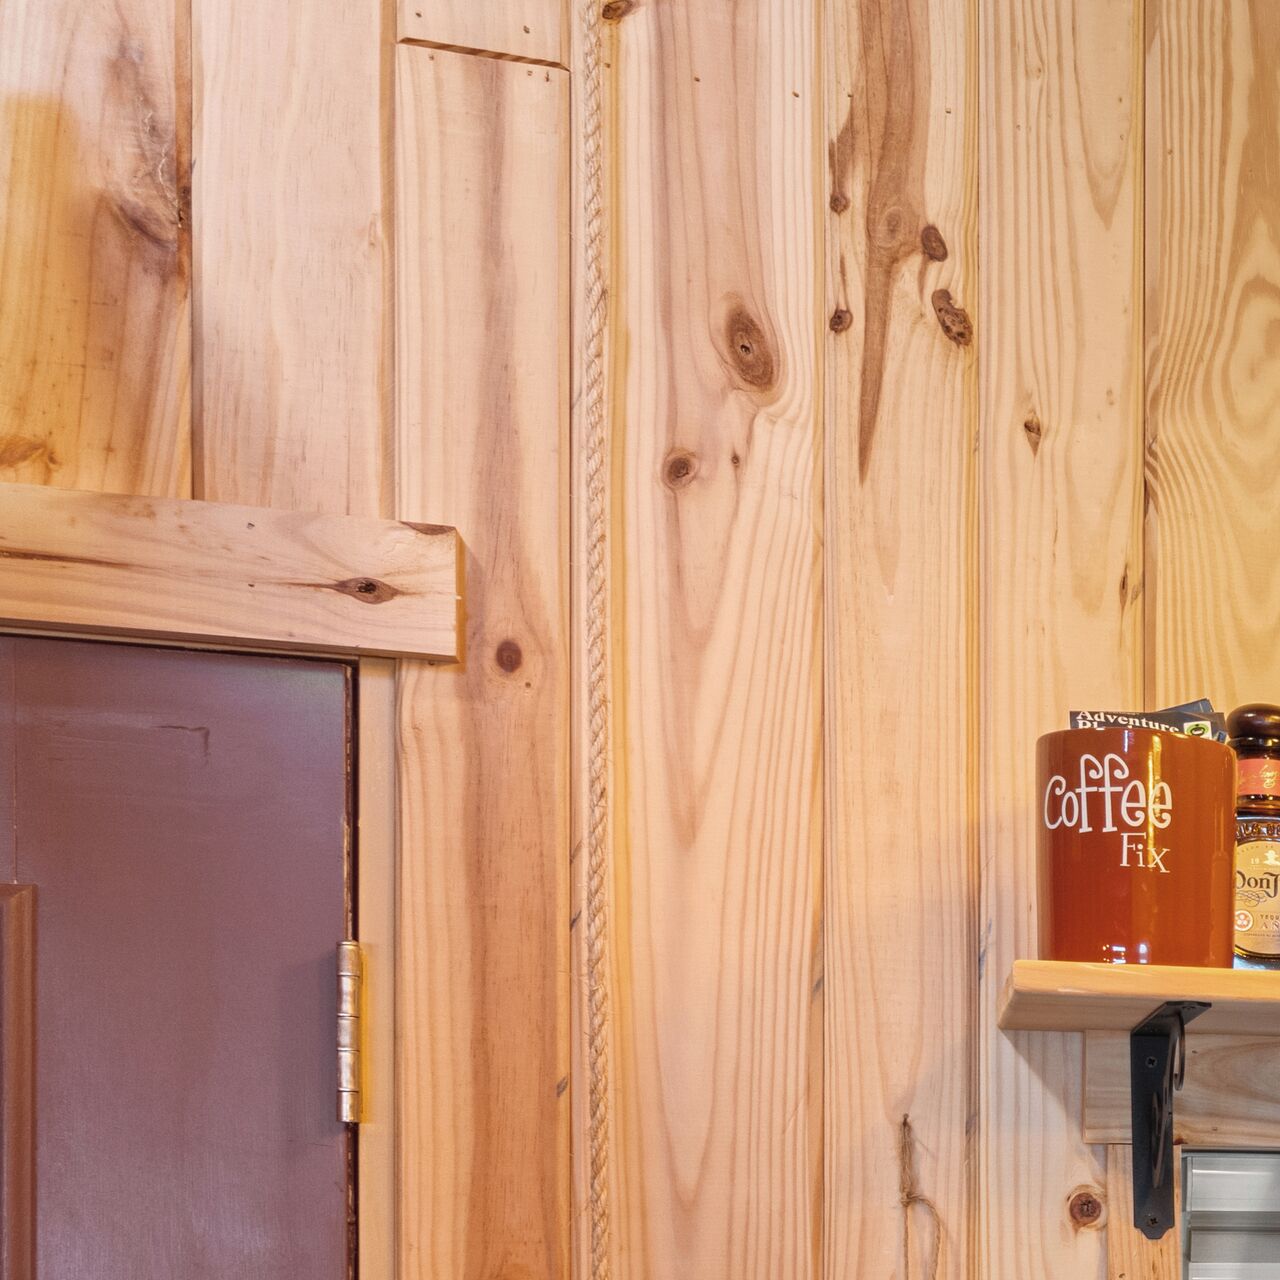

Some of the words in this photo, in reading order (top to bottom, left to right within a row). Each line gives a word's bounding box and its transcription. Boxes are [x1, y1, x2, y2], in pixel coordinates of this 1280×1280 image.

[1076, 711, 1180, 733] Adventure
[1044, 753, 1173, 833] Coffee
[1120, 832, 1170, 873] Fix
